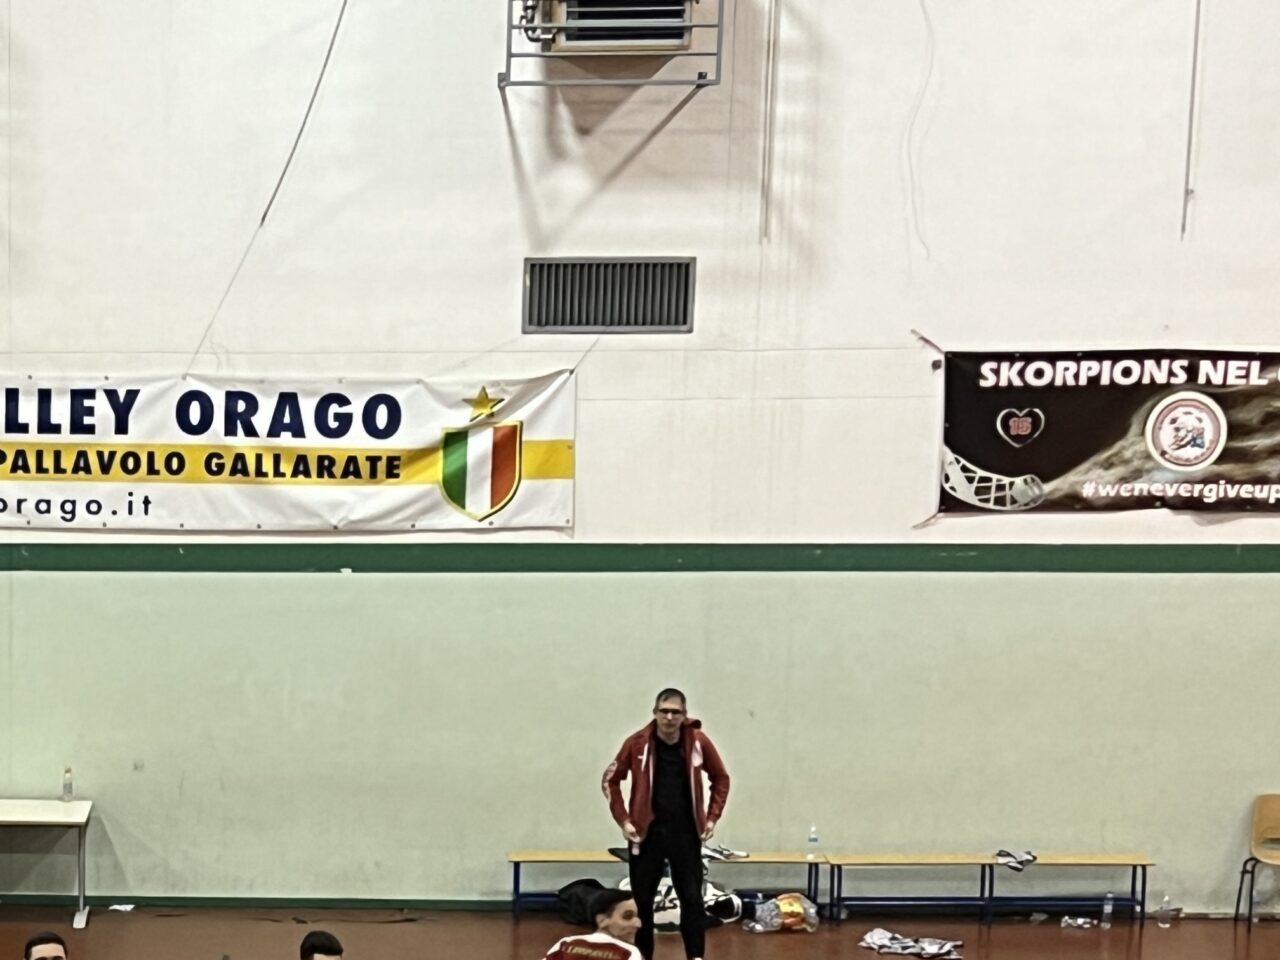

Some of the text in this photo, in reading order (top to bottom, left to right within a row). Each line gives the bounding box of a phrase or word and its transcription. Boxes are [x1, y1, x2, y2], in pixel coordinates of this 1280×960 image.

[978, 358, 1189, 388] SKORPIONS
[1197, 359, 1270, 386] NEL
[175, 389, 403, 440] ORAGO
[203, 451, 403, 481] GALLARATE
